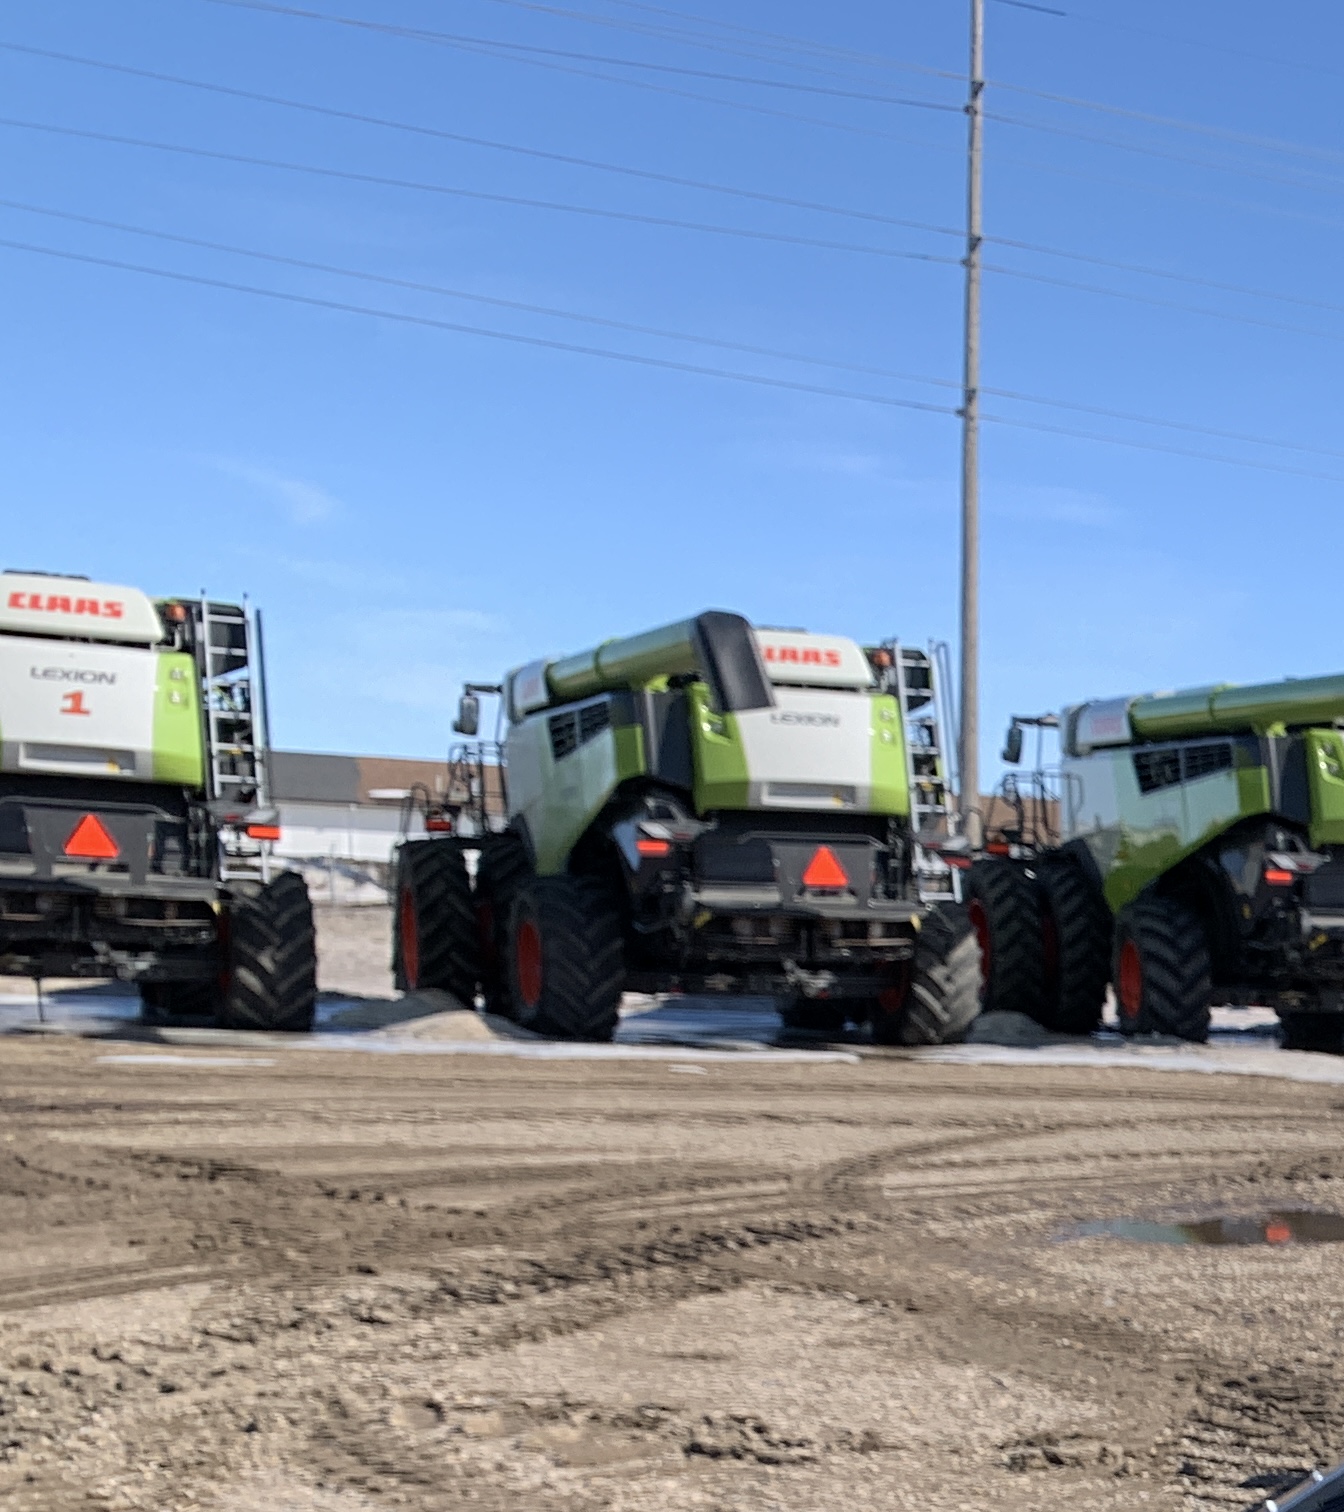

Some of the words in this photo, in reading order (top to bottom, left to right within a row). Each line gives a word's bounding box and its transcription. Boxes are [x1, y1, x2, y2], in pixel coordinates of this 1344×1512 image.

[7, 591, 125, 619] CLAAS
[762, 646, 841, 667] LAAS
[29, 666, 117, 685] LEXION
[59, 691, 91, 716] 1
